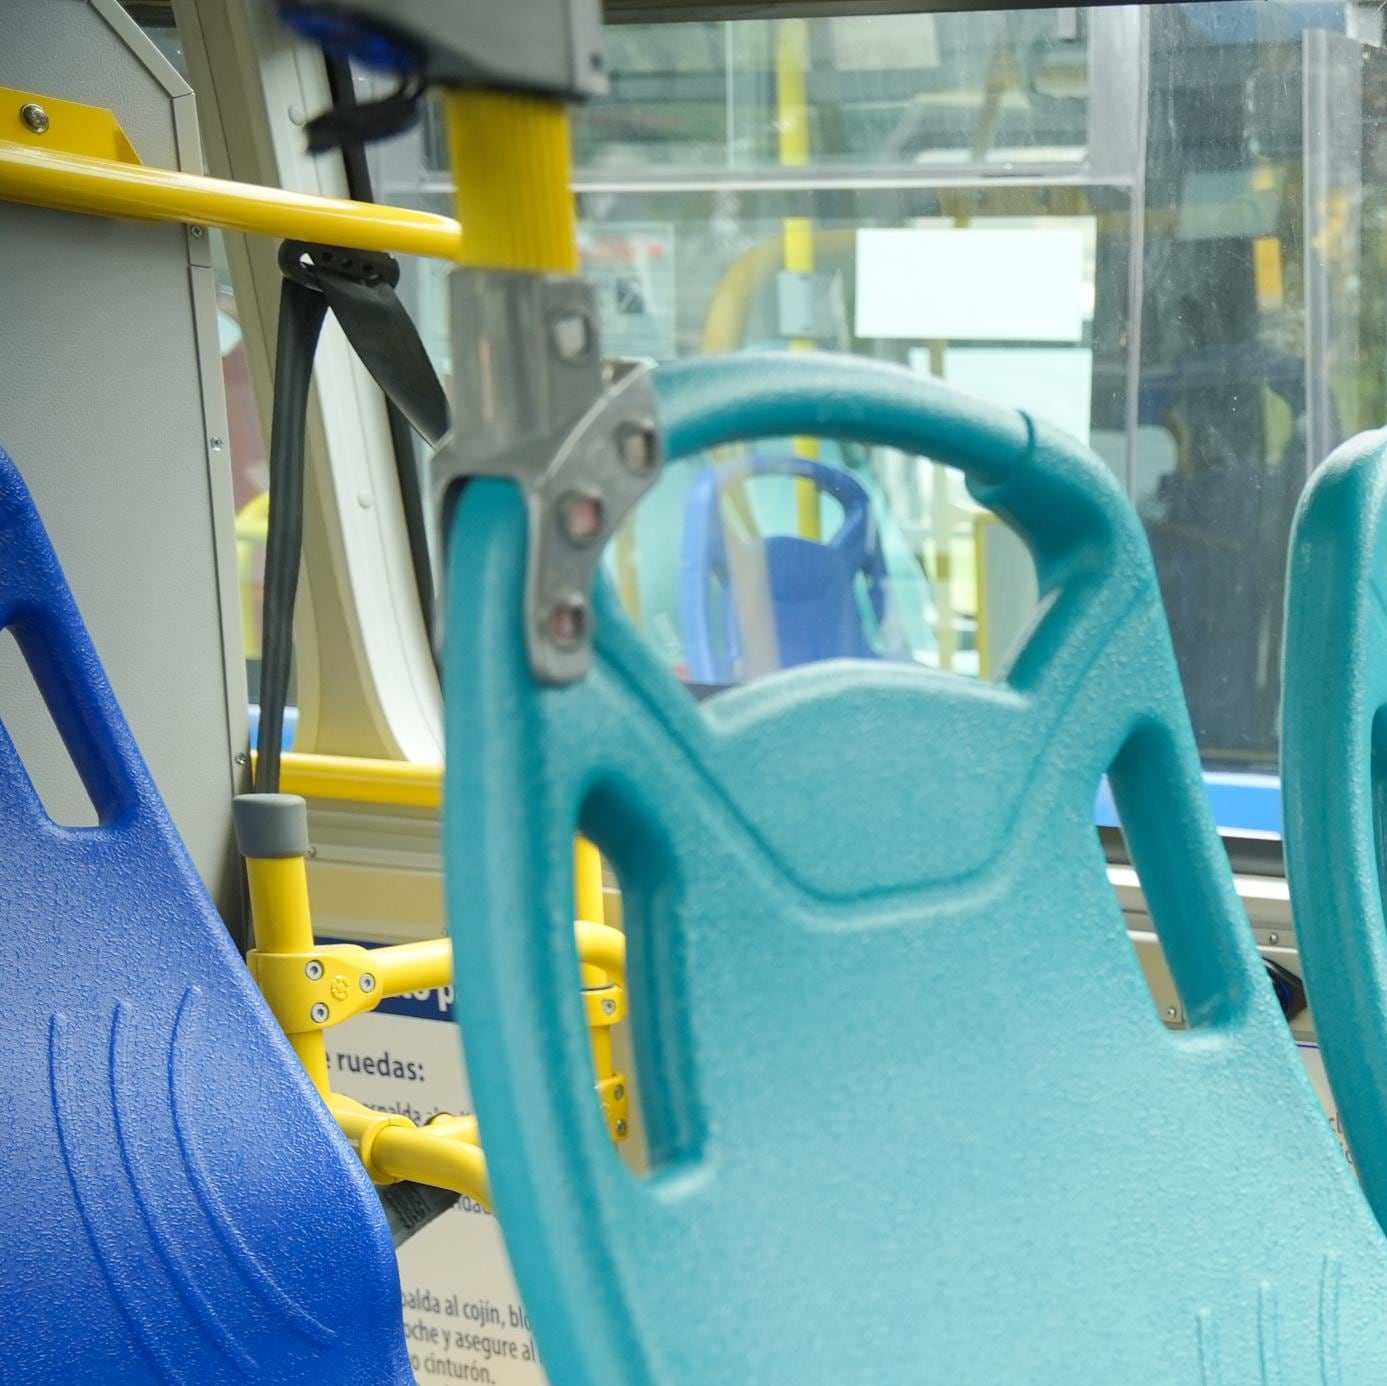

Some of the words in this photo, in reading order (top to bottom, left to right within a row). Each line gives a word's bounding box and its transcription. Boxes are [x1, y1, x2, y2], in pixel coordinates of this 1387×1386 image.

[337, 1051, 425, 1082] ruedas:
[444, 1295, 460, 1317] al
[462, 1300, 506, 1330] cojín,
[404, 1319, 439, 1344] oche
[455, 1330, 519, 1360] asegure
[522, 1339, 537, 1362] al
[424, 1351, 497, 1386] cinturón.
